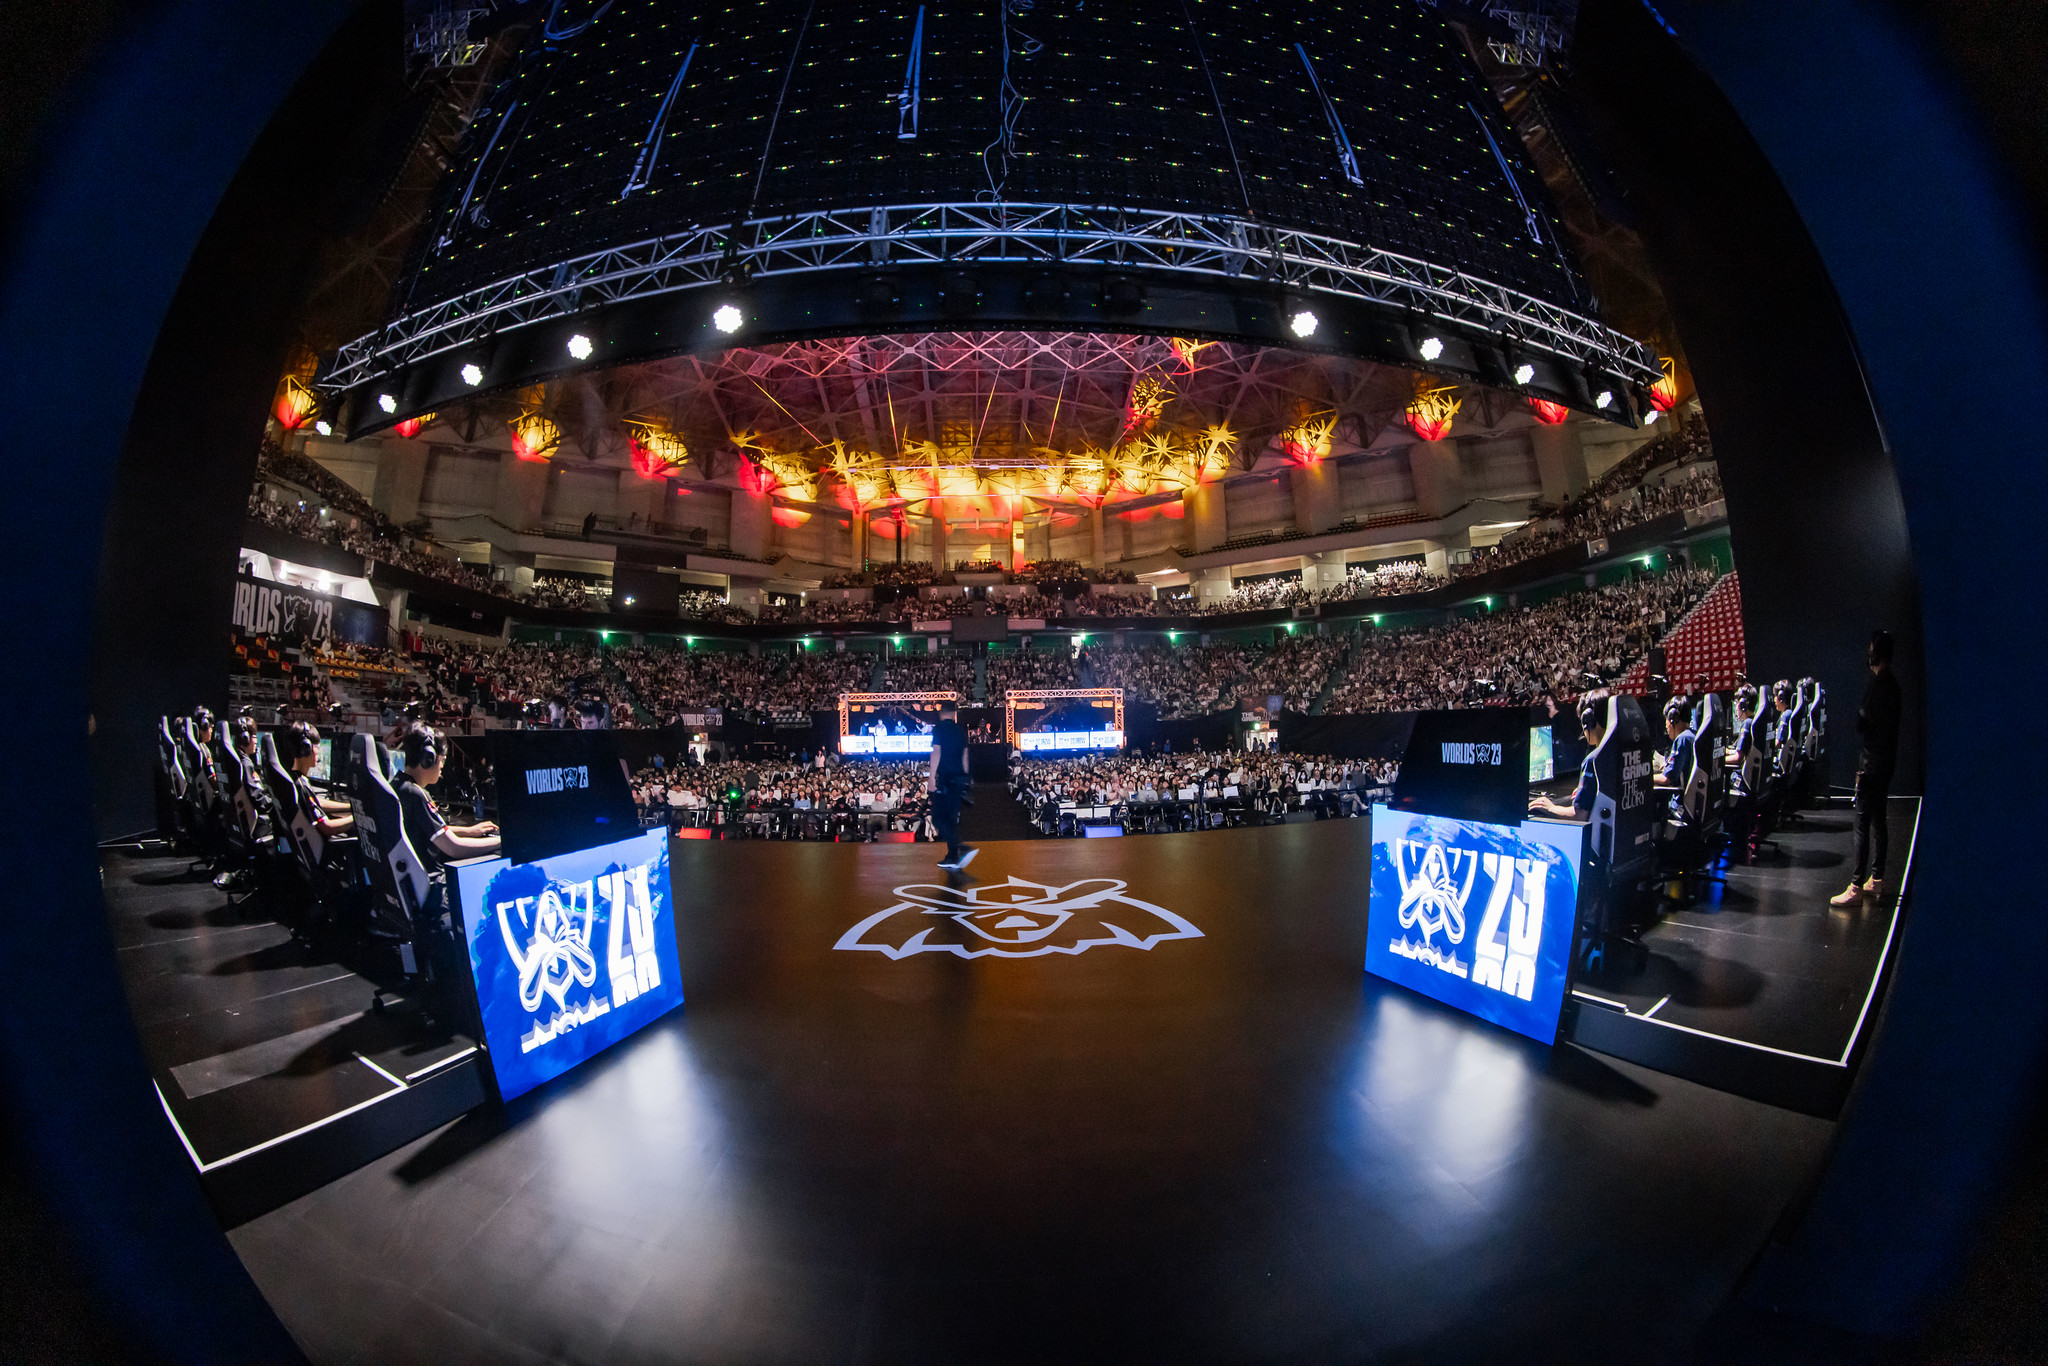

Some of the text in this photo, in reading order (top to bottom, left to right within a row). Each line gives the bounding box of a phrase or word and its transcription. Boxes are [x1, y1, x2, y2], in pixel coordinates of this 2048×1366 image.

[232, 581, 282, 635] RLDS
[1441, 742, 1502, 766] WORLDS 23
[1622, 750, 1641, 767] THE
[525, 765, 589, 795] WORLDS 23
[1622, 762, 1651, 781] GRIND
[1622, 779, 1639, 796] THE
